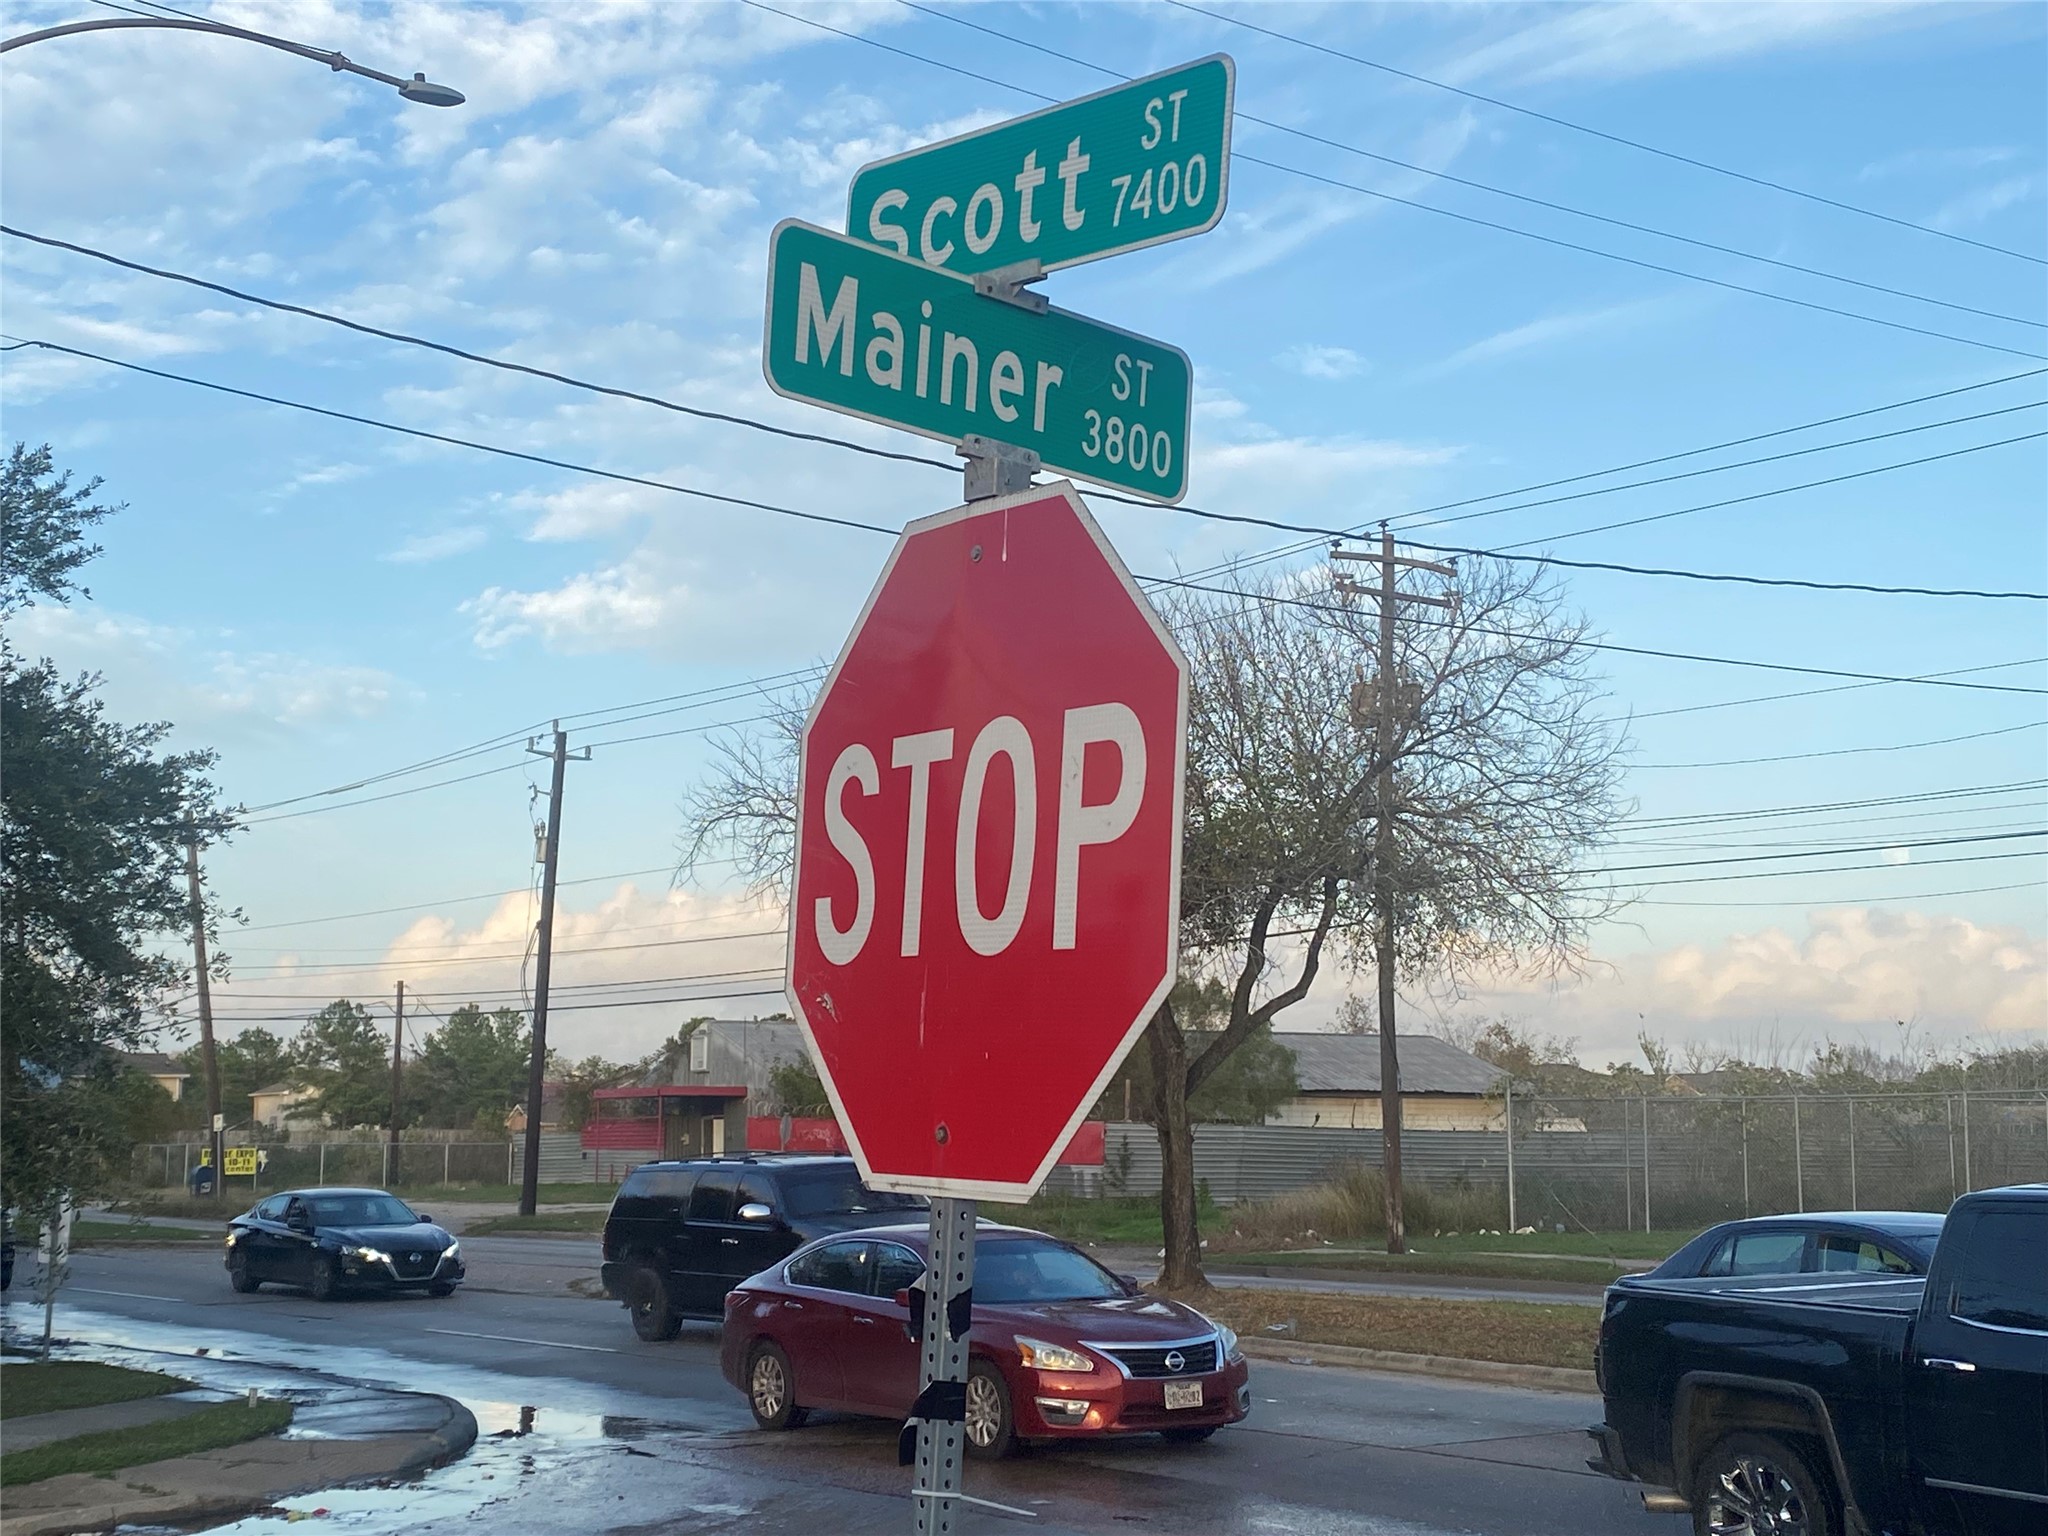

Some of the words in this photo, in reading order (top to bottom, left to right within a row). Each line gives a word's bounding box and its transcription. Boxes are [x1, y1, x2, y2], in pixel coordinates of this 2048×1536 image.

[1141, 89, 1188, 151] ST
[869, 136, 1091, 265] Scott
[1111, 153, 1207, 228] 7400
[794, 262, 1064, 433] Mainer
[1111, 353, 1154, 407] ST
[1081, 409, 1172, 479] 3800
[814, 701, 1148, 967] STOP
